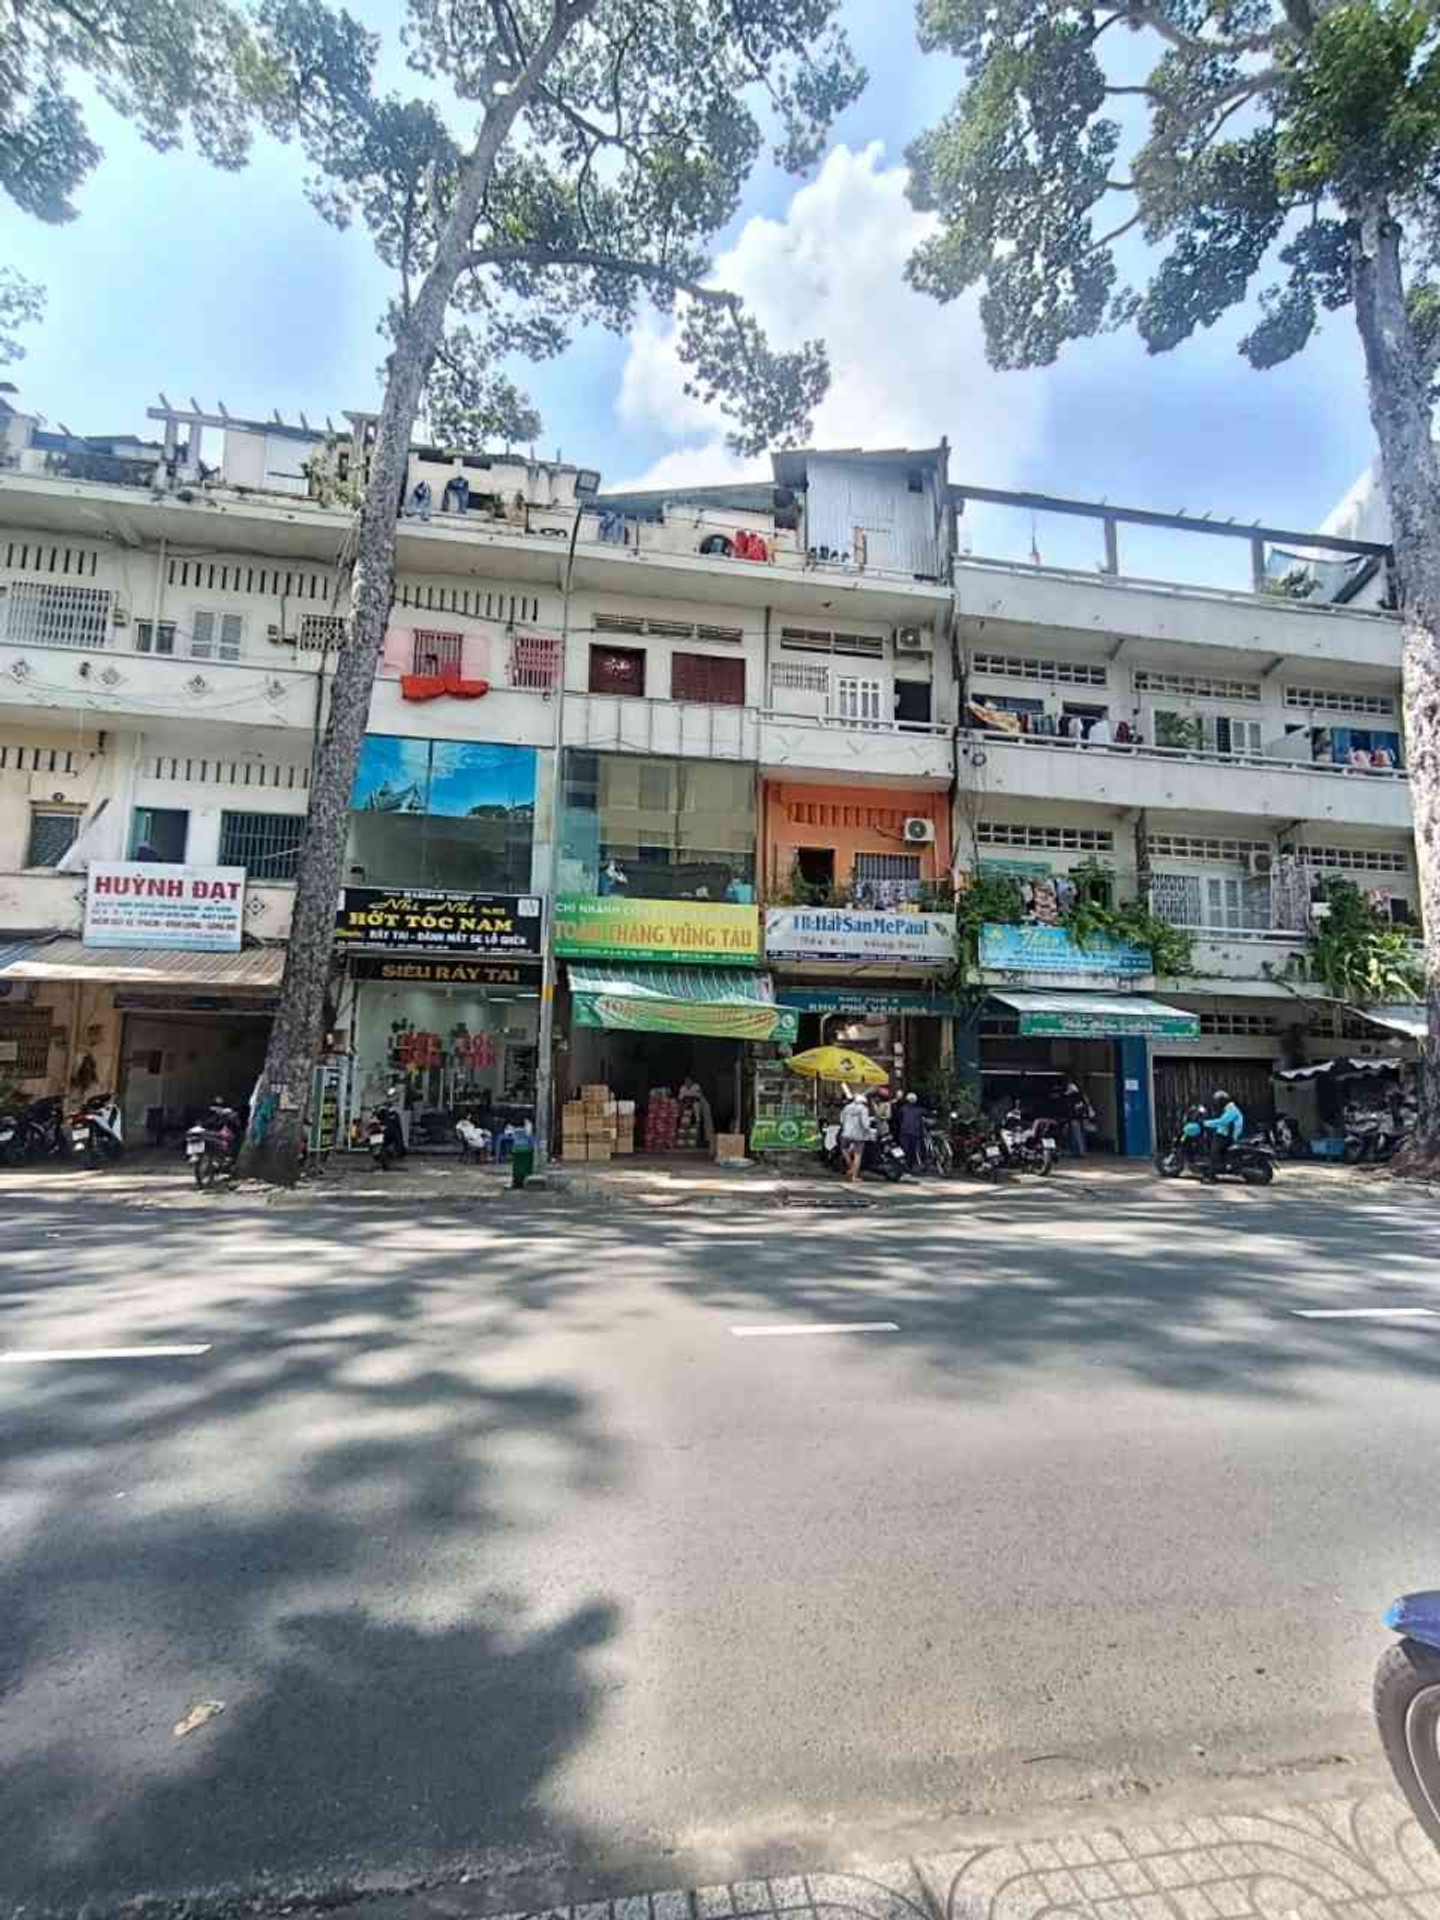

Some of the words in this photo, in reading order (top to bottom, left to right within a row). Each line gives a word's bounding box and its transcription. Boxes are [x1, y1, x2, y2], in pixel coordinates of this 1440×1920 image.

[192, 880, 241, 904] ĐẠT
[349, 910, 400, 927] HỚT
[405, 912, 454, 929] TÓC
[459, 917, 512, 933] NAM
[436, 964, 480, 980] RÁY
[484, 968, 520, 982] TAI
